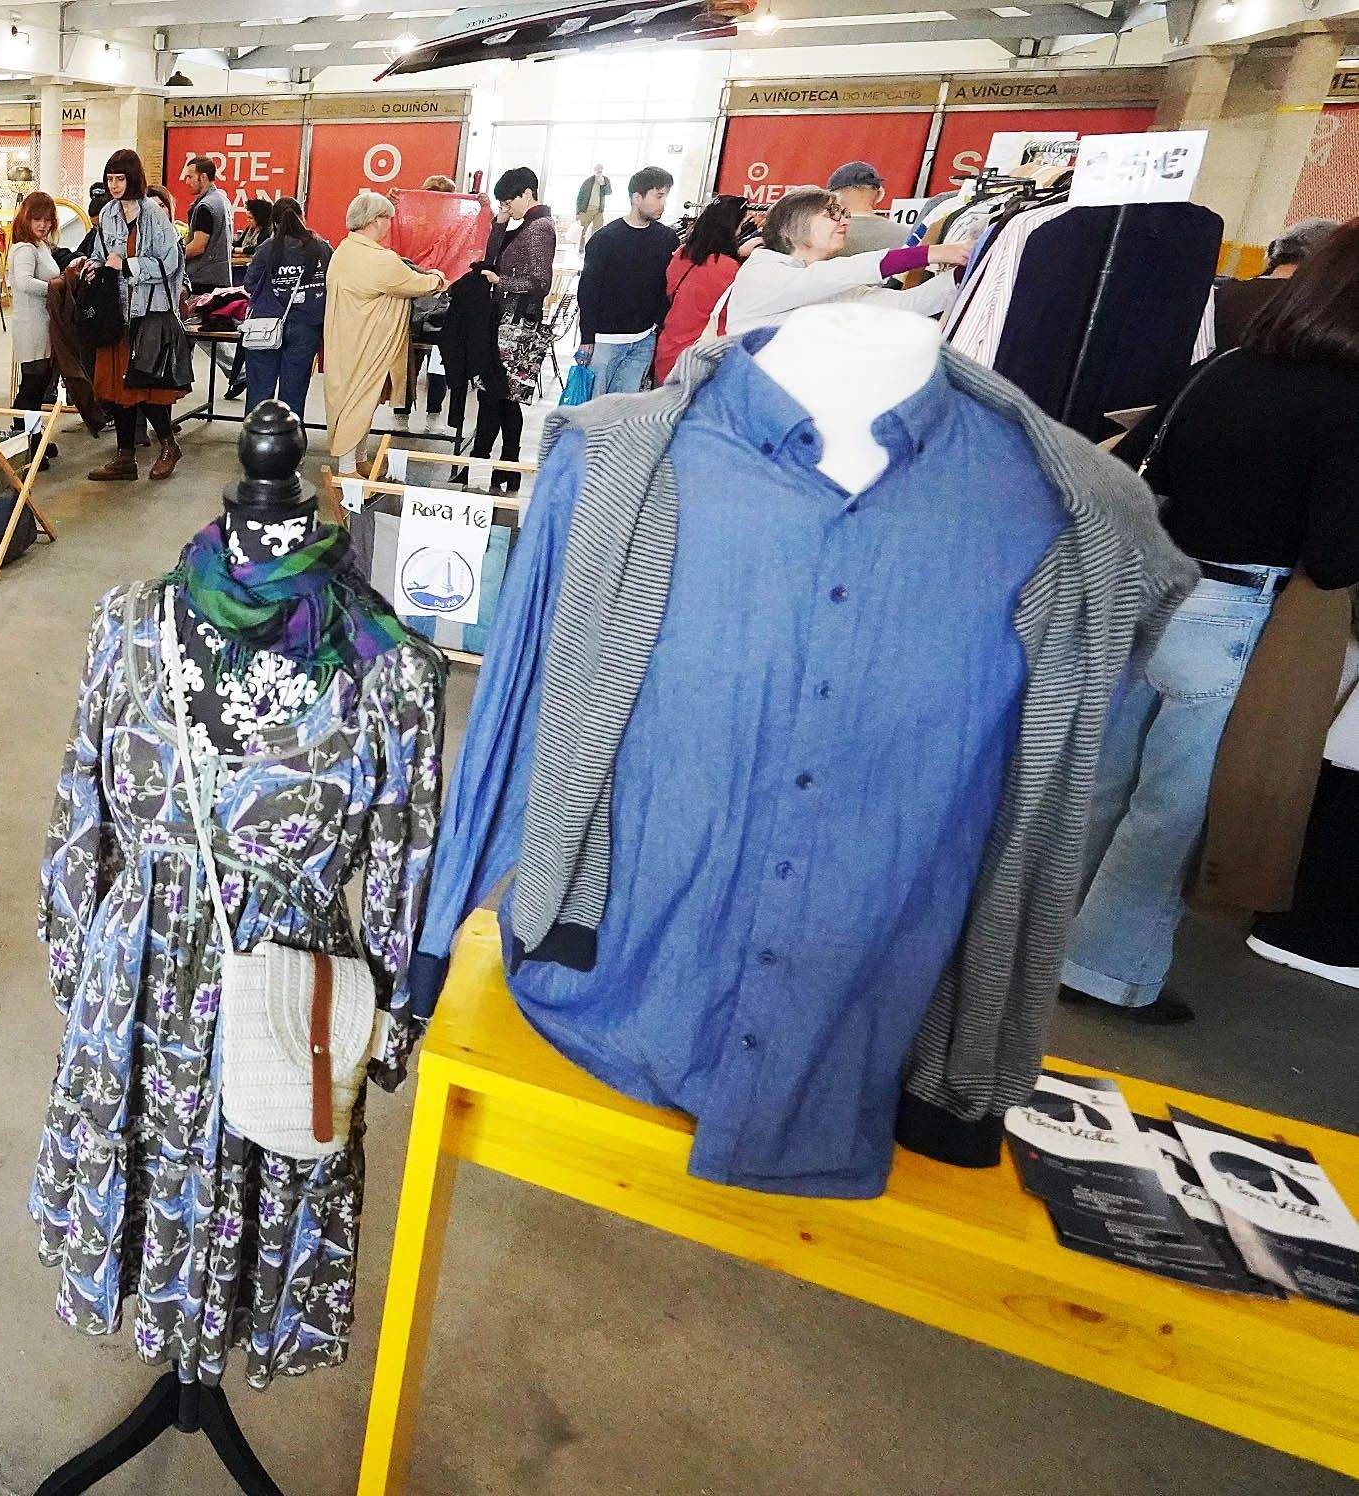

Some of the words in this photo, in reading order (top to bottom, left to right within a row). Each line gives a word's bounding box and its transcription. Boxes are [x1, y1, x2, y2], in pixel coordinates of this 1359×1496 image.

[749, 92, 760, 103] A
[763, 88, 839, 102] VIÑOTECA
[954, 86, 966, 99] A
[971, 82, 1059, 98] VIÑOTECA
[230, 102, 270, 116] POKE
[392, 101, 439, 113] QUIÑÓN
